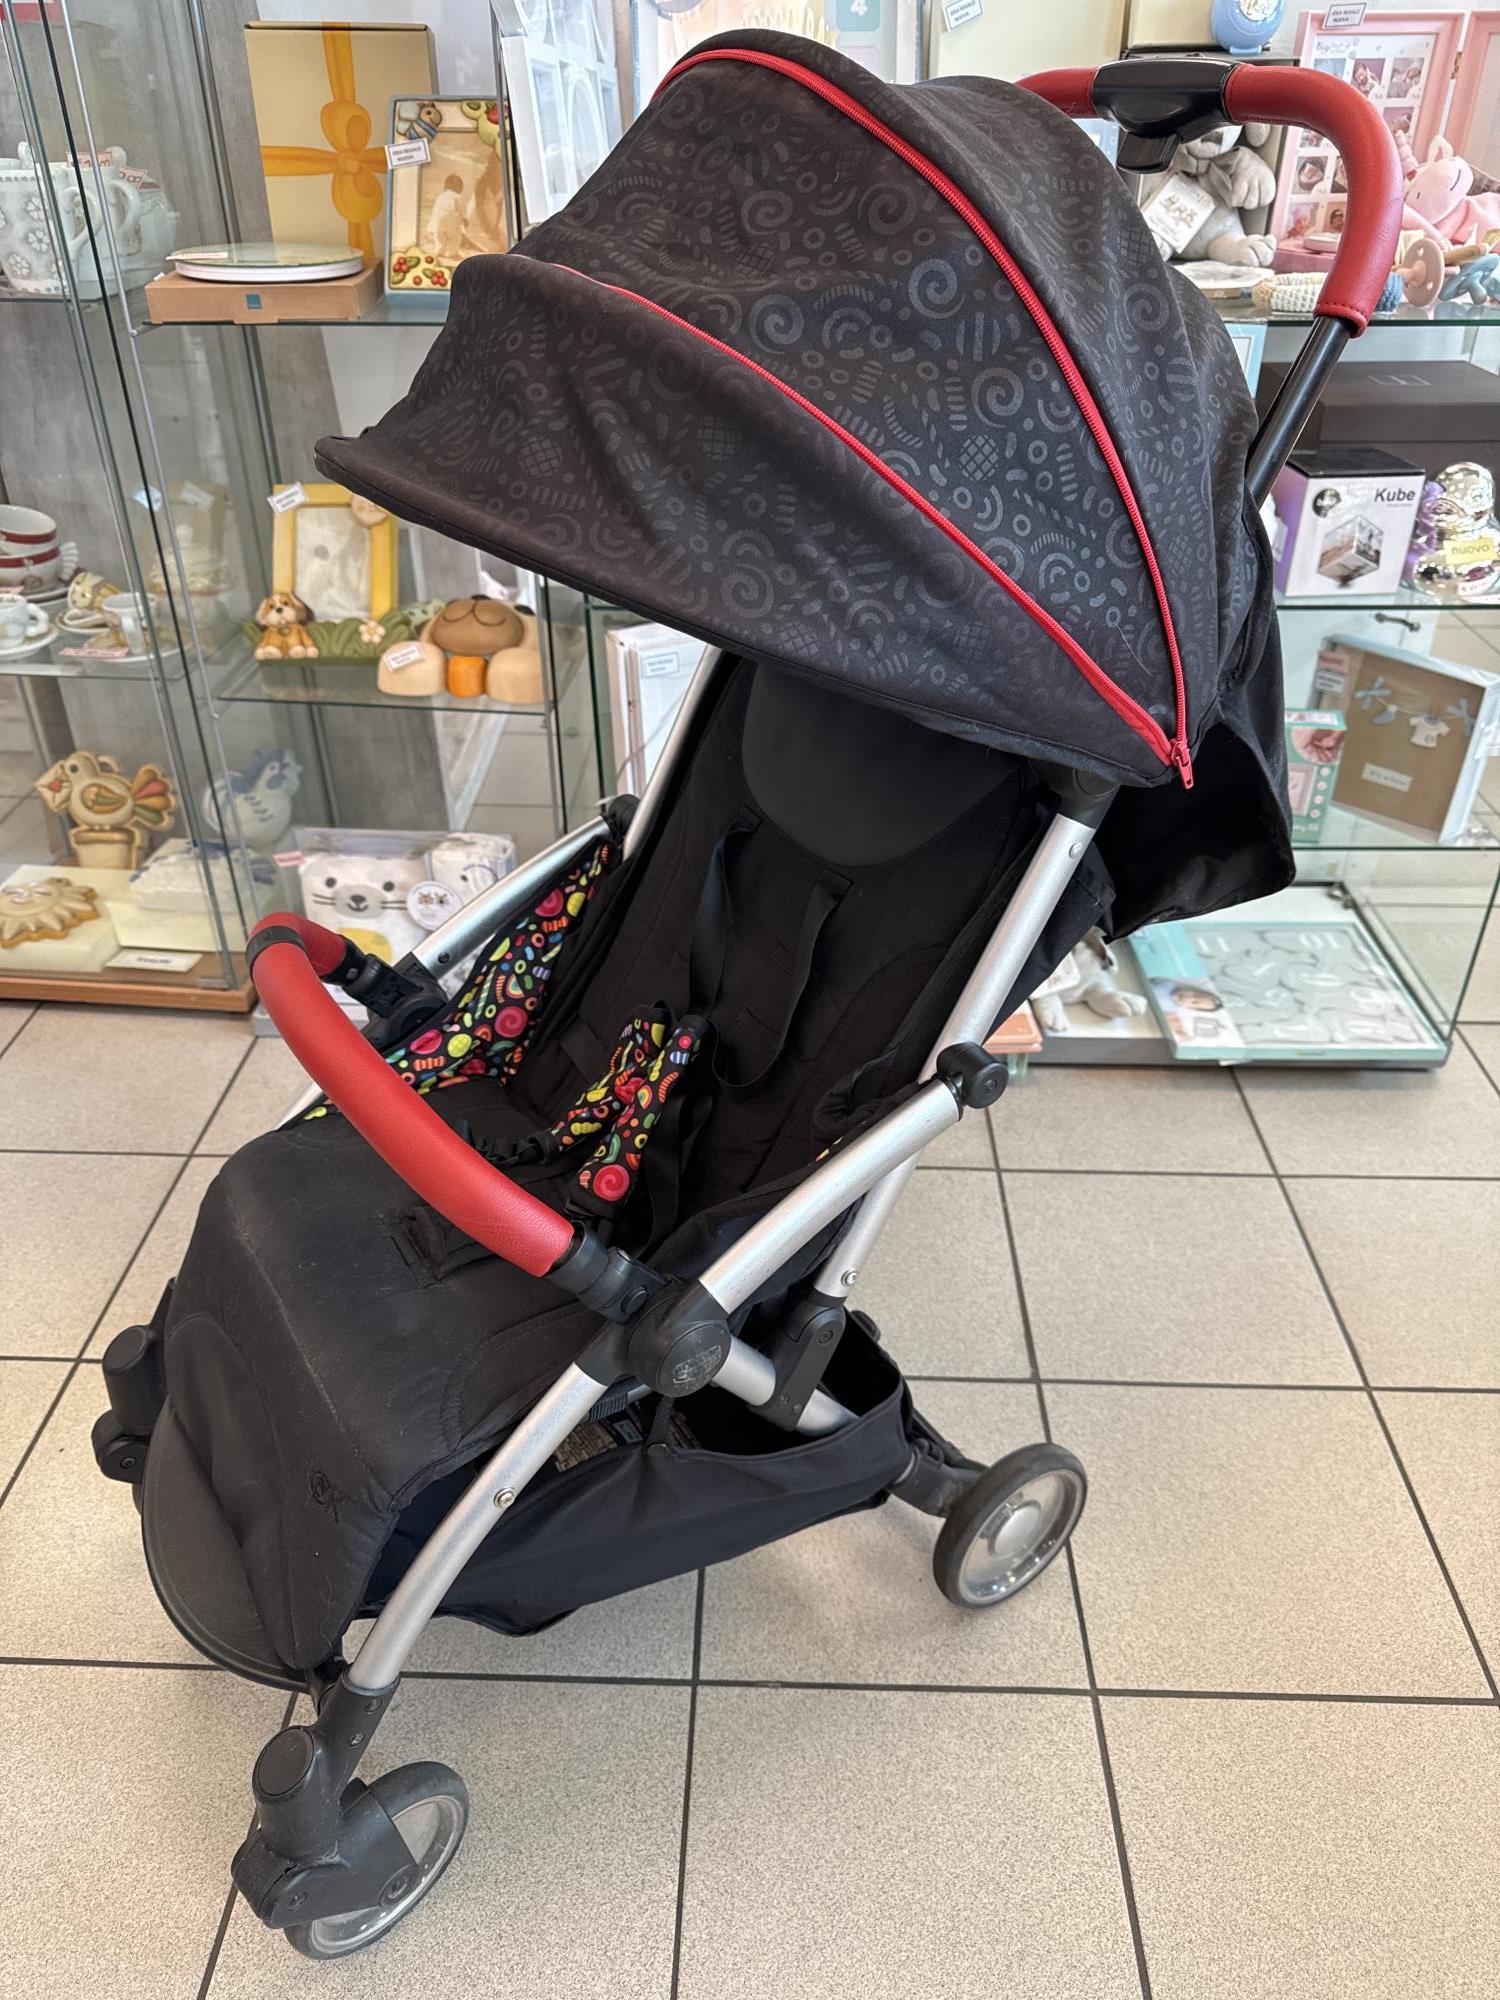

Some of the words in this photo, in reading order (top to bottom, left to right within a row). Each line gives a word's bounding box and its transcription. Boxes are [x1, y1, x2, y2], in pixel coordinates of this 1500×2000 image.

[850, 0, 868, 16] 4
[1374, 488, 1416, 502] Kube
[1451, 544, 1490, 555] nuovo
